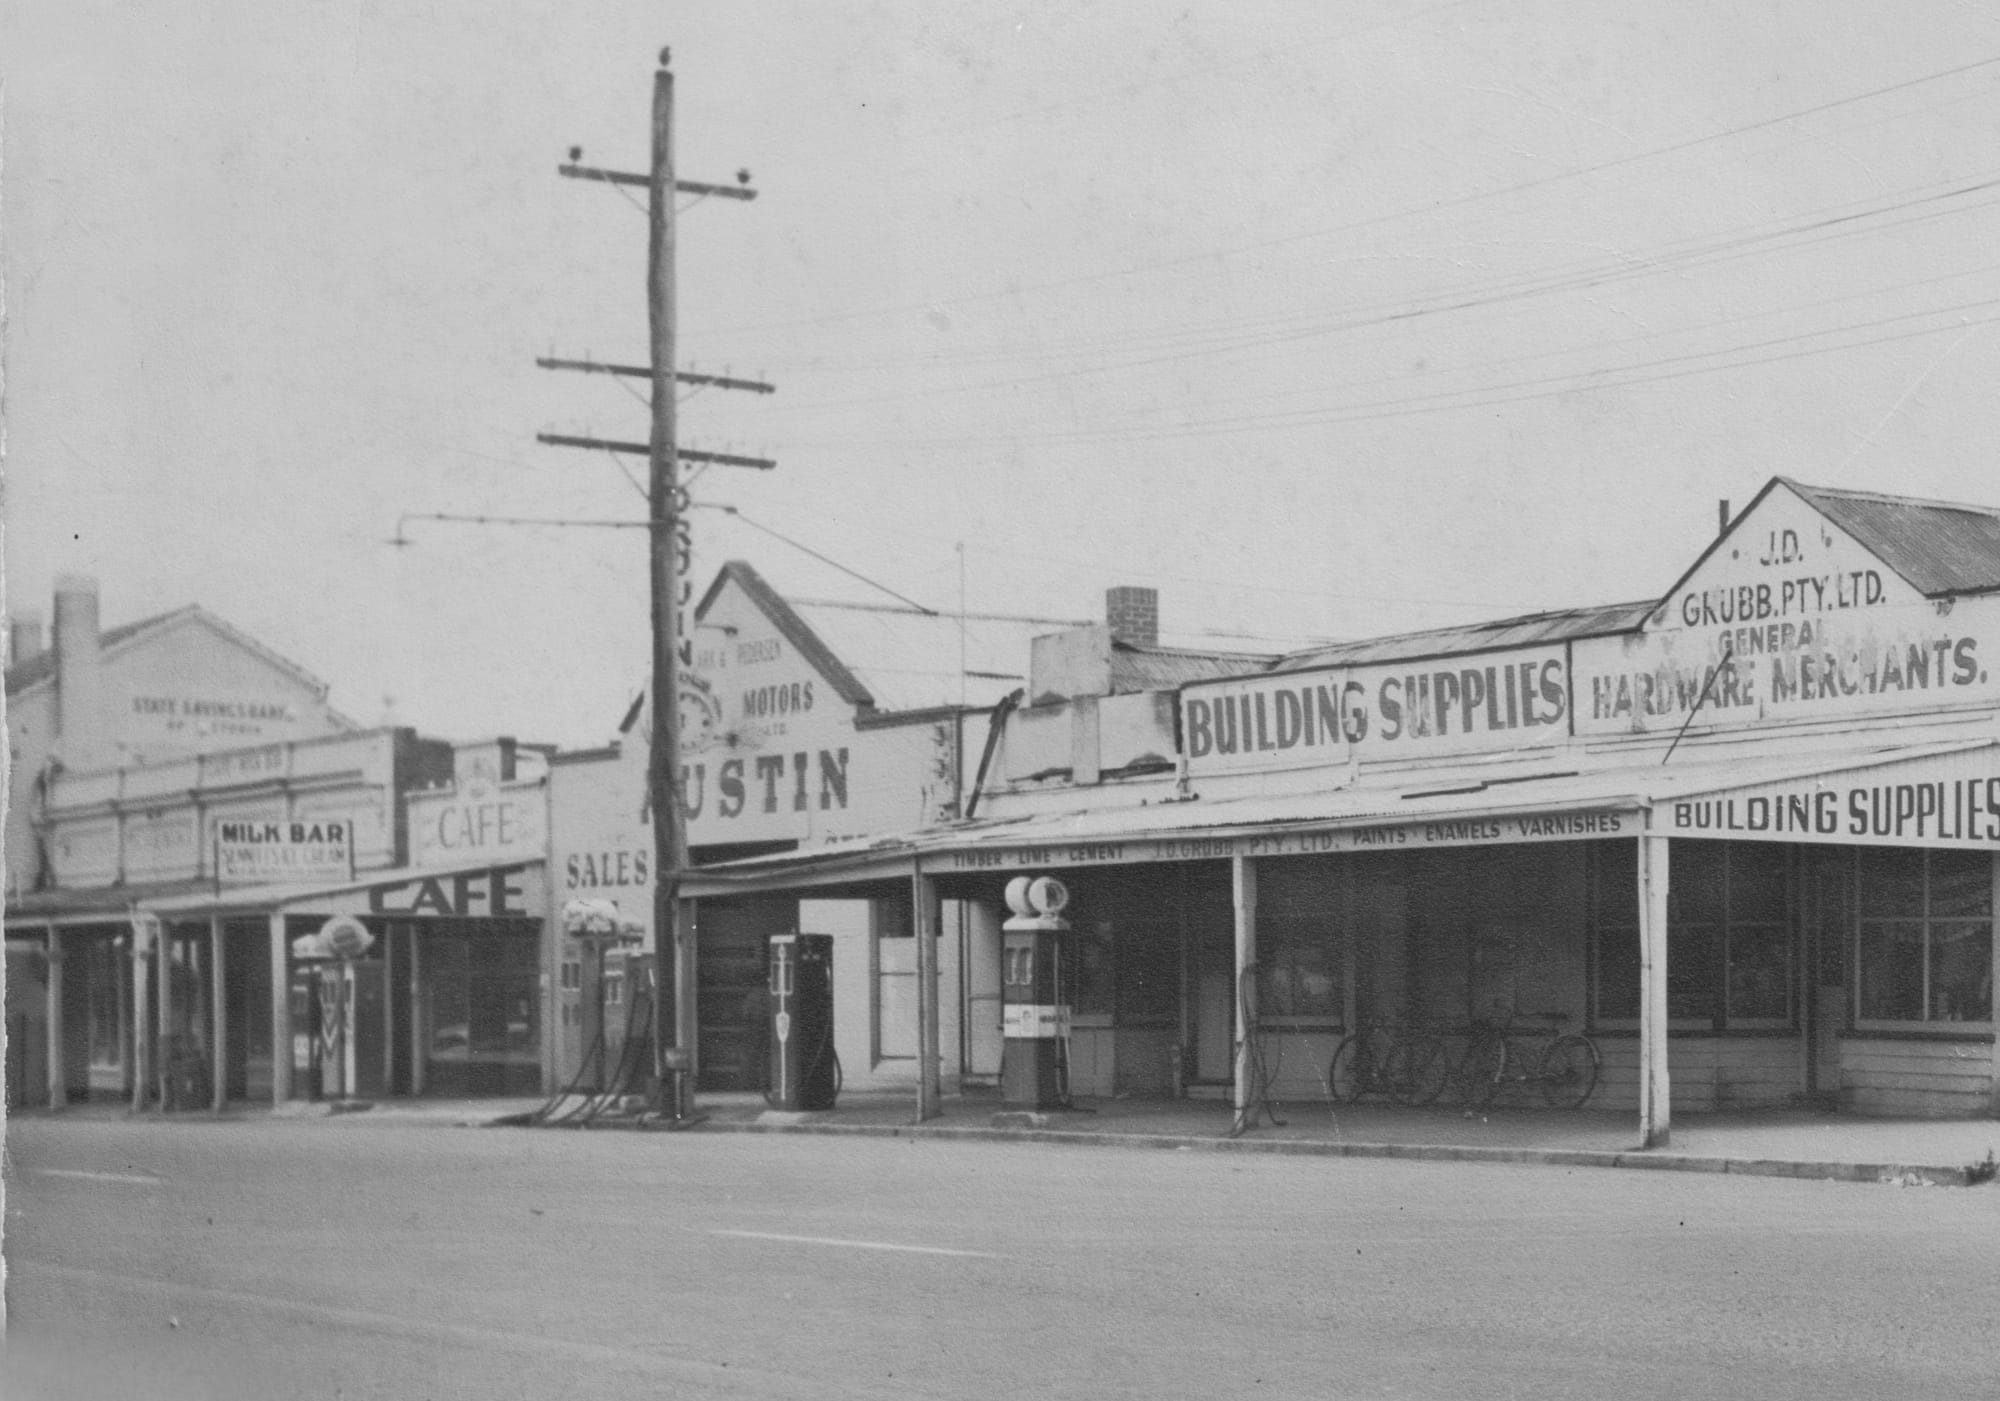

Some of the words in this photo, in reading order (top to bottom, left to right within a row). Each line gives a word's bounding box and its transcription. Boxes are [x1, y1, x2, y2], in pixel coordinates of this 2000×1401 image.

[1760, 529, 1803, 566] J.D.
[132, 697, 176, 714] STATE
[743, 680, 814, 717] MOTORS
[1187, 682, 1368, 759] BUILDING
[1378, 658, 1566, 742] SUPPLIES
[439, 802, 515, 849] CAFE
[1675, 790, 1838, 834] BUILDING
[1849, 777, 2000, 841] SUPPLIES
[222, 823, 280, 843] MILK
[290, 823, 344, 843] BAR
[953, 852, 1003, 868] TIMBER
[1018, 849, 1051, 865] LIME
[1069, 846, 1124, 862] CEMENT
[1353, 825, 1406, 846] PAINTS
[1426, 821, 1501, 842] ENAMELS
[1518, 812, 1622, 837] VARNISHES
[369, 863, 527, 917] CAFE
[566, 849, 648, 889] SALES
